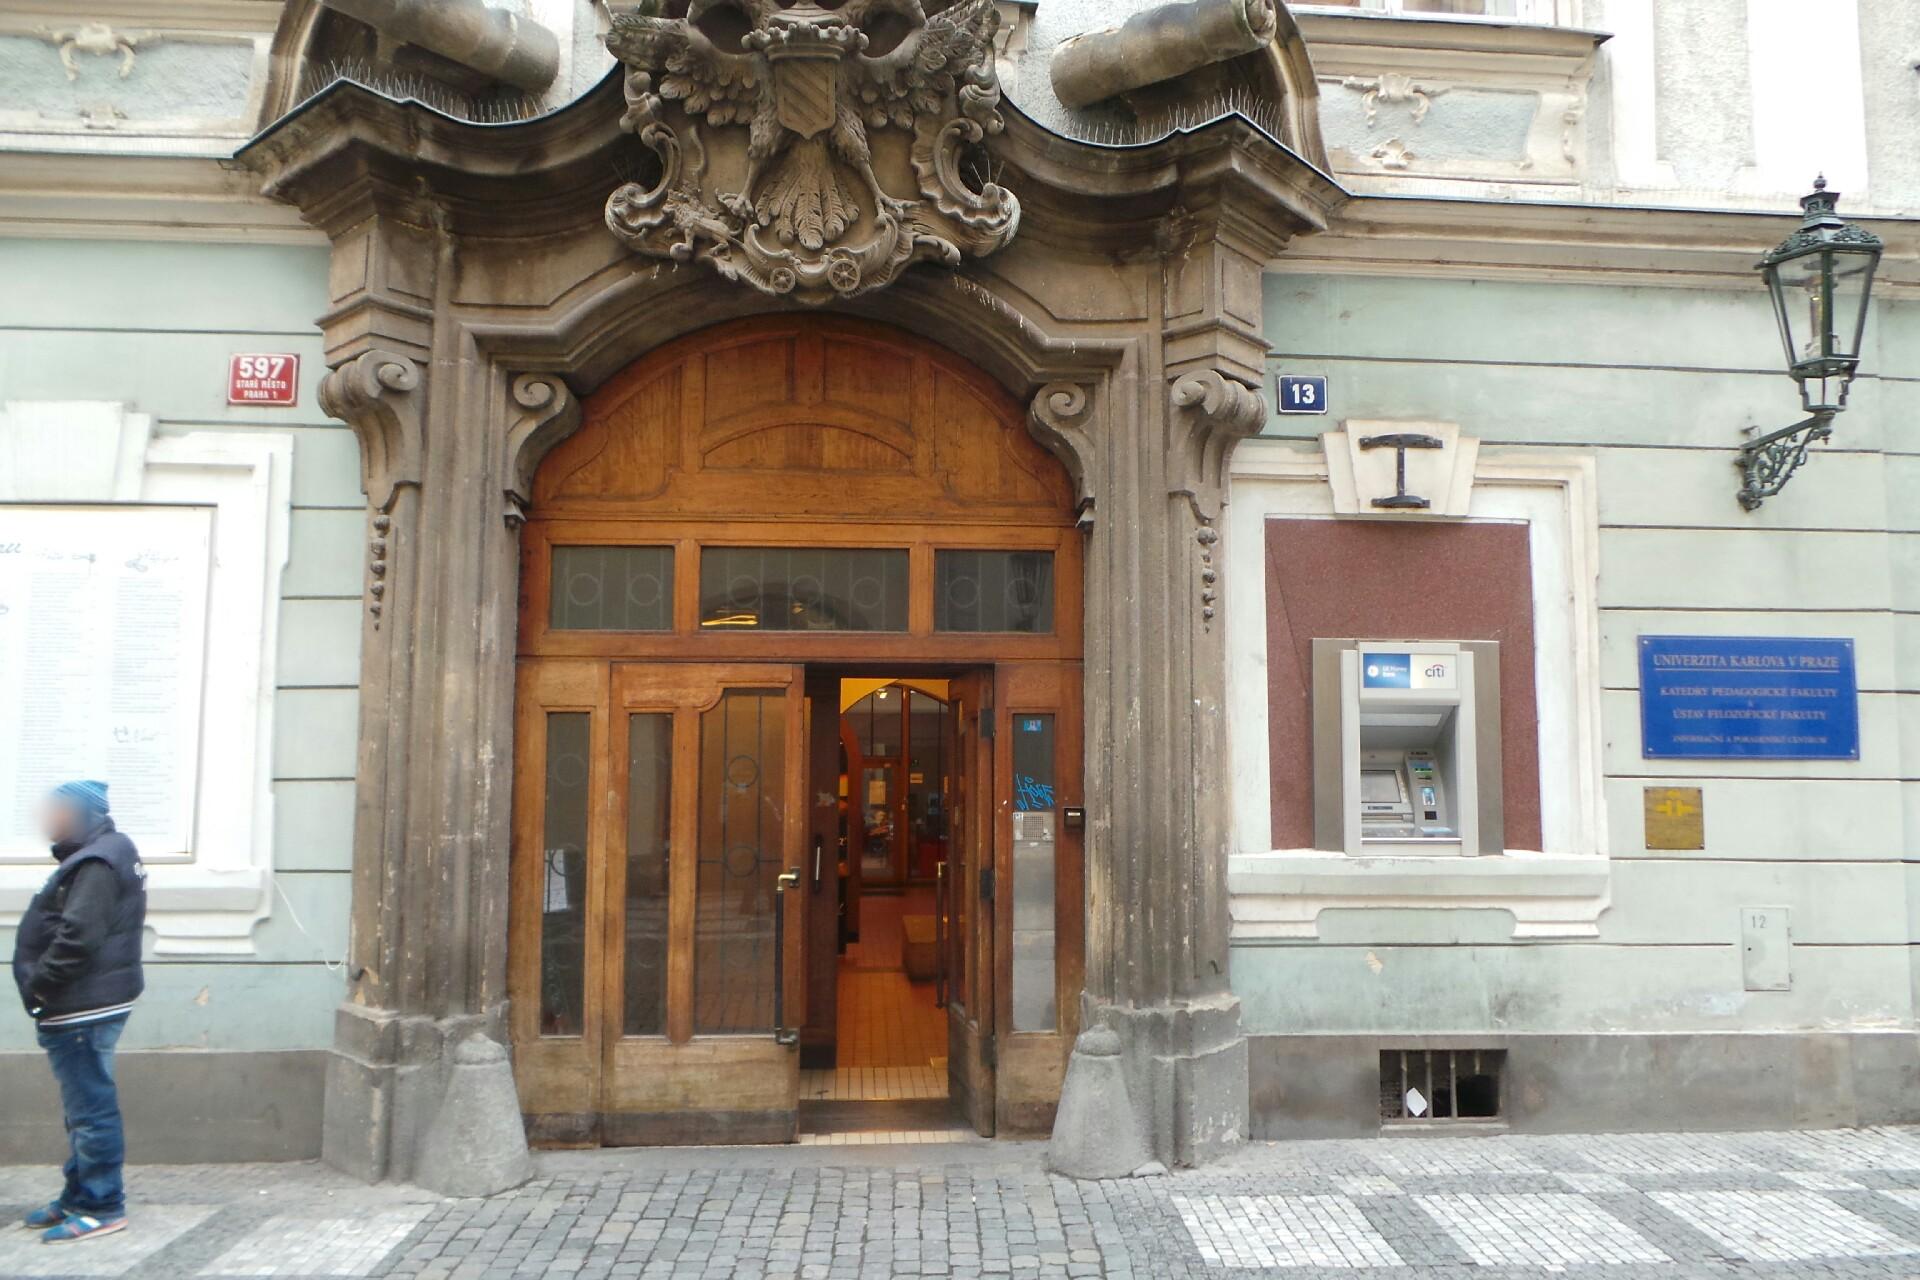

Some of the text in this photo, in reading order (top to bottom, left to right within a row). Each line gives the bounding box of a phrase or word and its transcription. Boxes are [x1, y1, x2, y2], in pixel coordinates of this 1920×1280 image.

[239, 357, 285, 379] 597
[236, 378, 287, 389] STARÉ MĚSTO
[243, 390, 279, 399] PRAHA 1
[1292, 383, 1315, 404] 13
[1654, 654, 1840, 669] UNIVERZITA KARLOVA V PRAZE
[1425, 664, 1445, 678] citi
[1661, 687, 1709, 696] KATEDRY
[1790, 688, 1838, 698] FAKULTY
[1780, 710, 1827, 720] FAKULTY
[1752, 914, 1767, 929] 12
